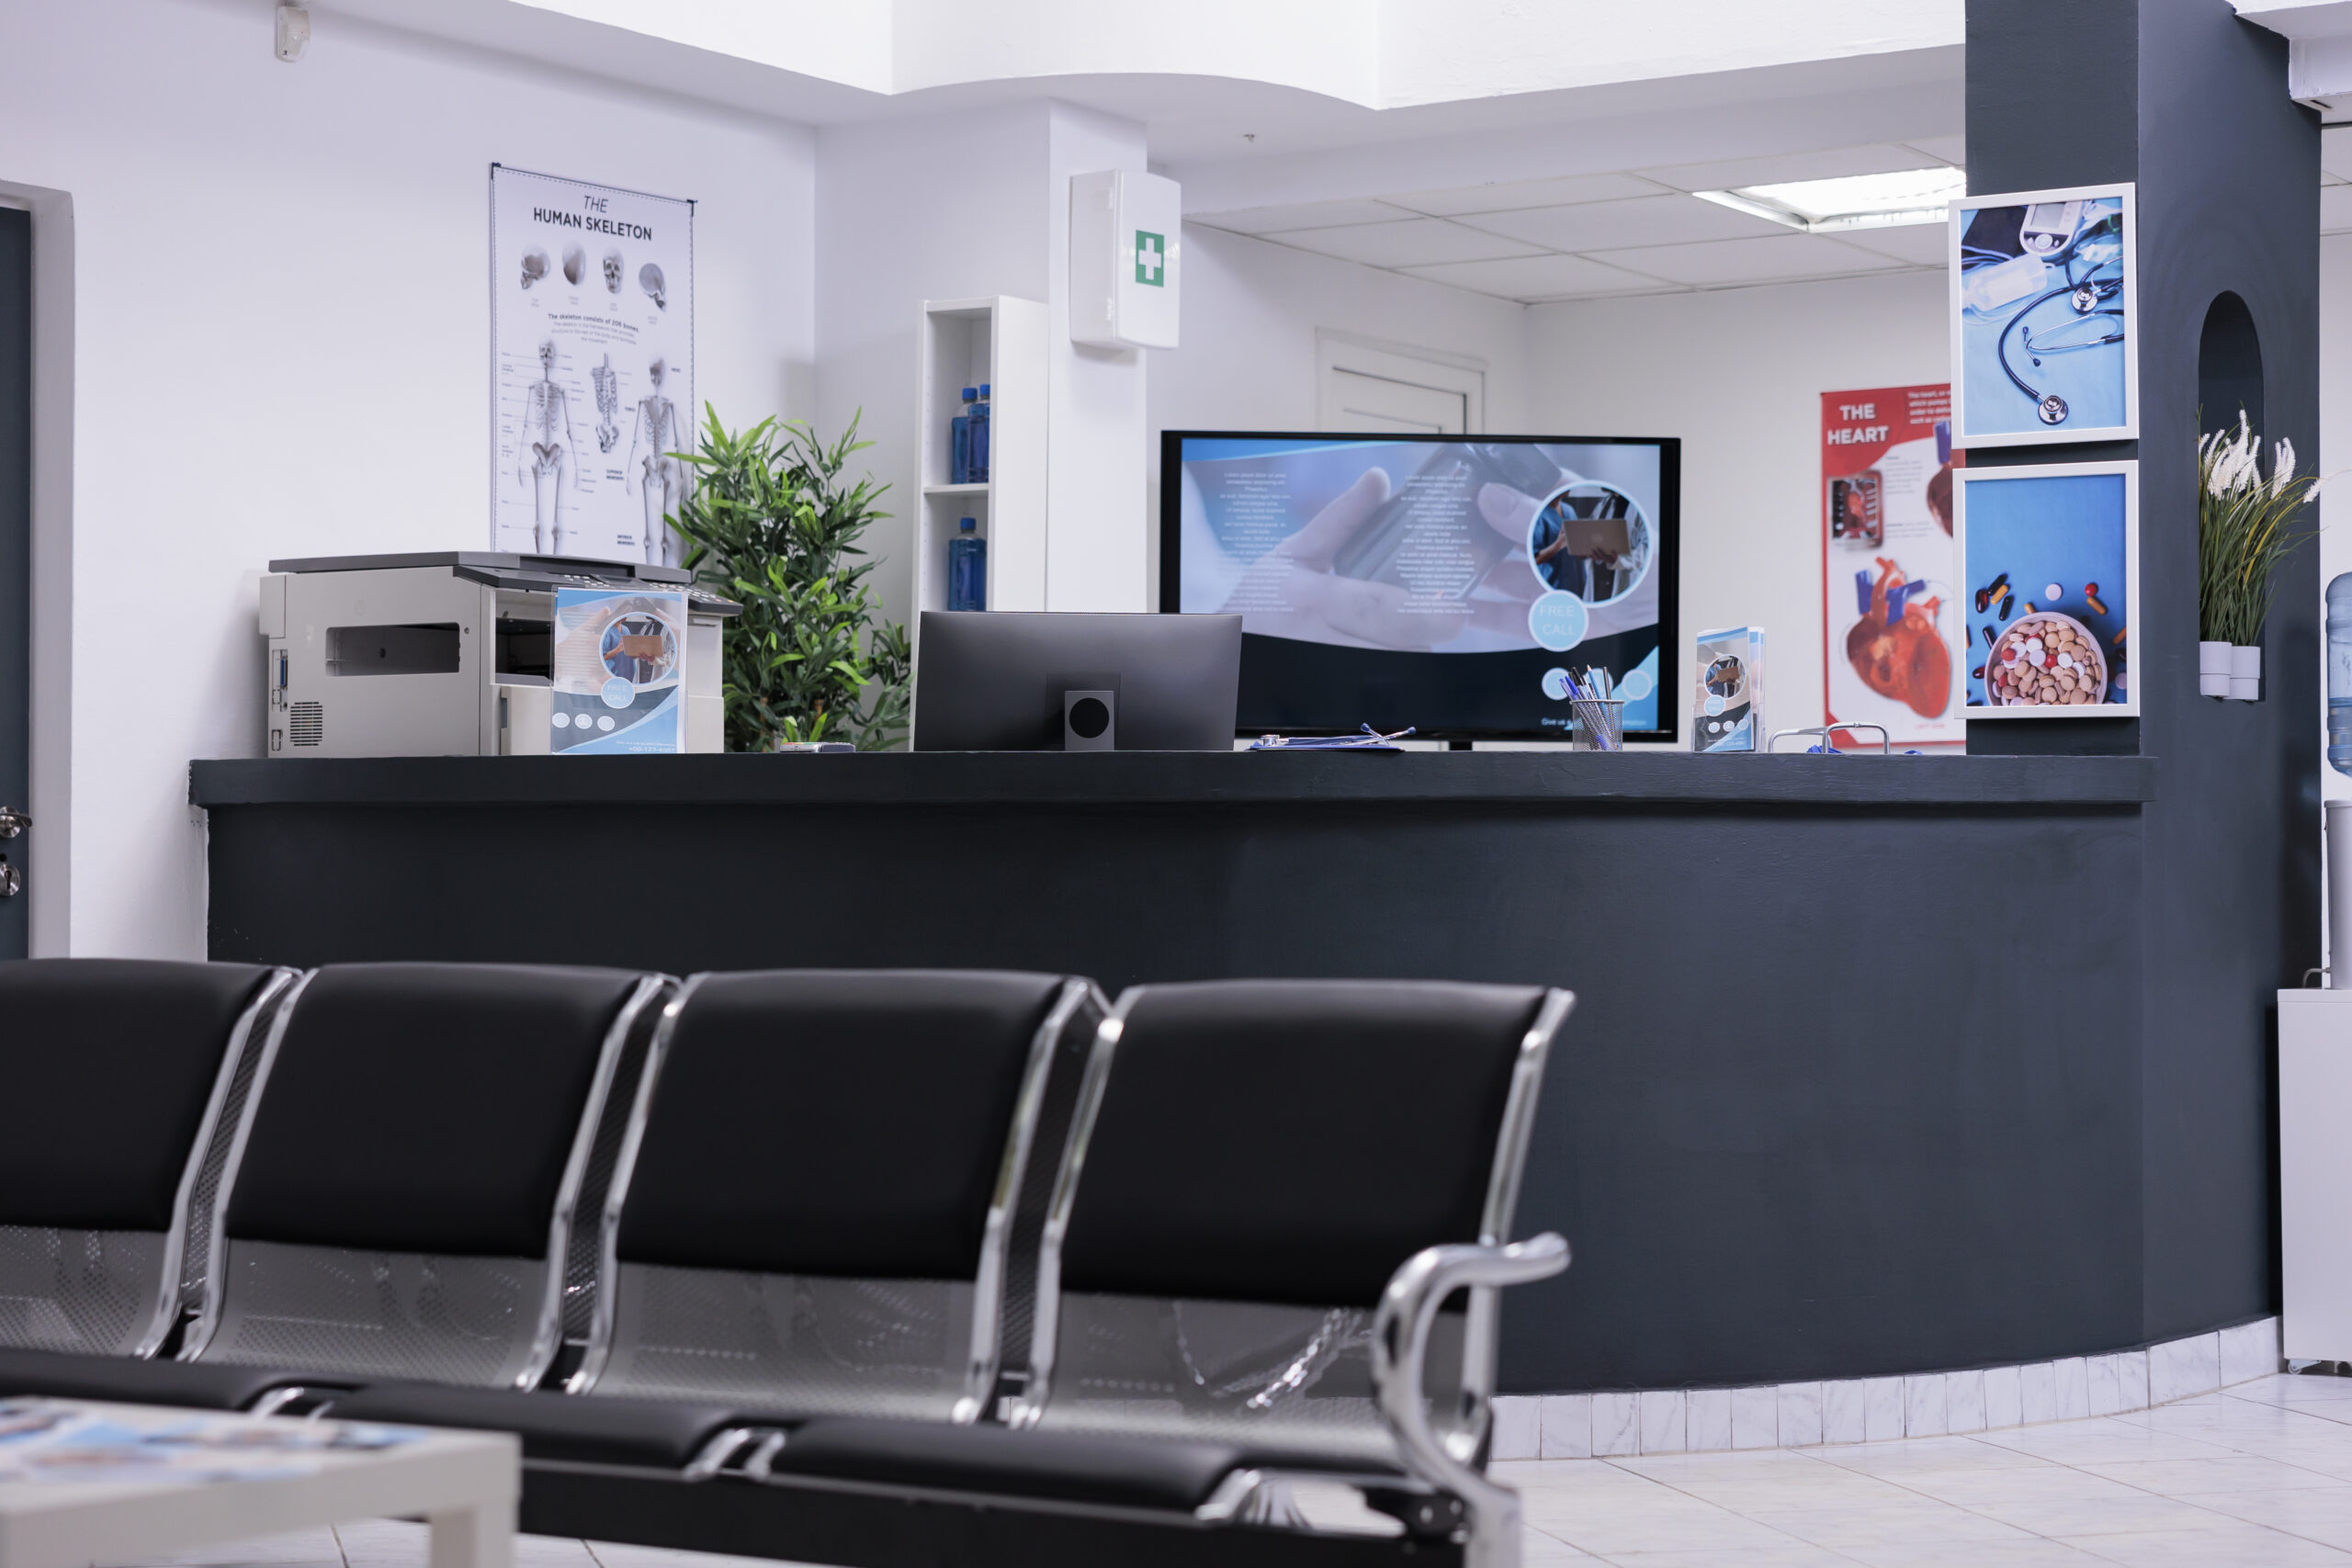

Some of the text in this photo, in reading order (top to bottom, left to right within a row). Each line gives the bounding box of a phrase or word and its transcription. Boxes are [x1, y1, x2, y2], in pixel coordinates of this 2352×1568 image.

[583, 195, 609, 214] THE
[533, 207, 652, 242] HUMAN SKELETON
[559, 313, 582, 321] skeleton
[582, 315, 604, 323] consists
[1839, 402, 1876, 421] THE
[1826, 425, 1889, 446] HEART
[1539, 604, 1575, 617] FREE
[1542, 624, 1576, 636] CALL
